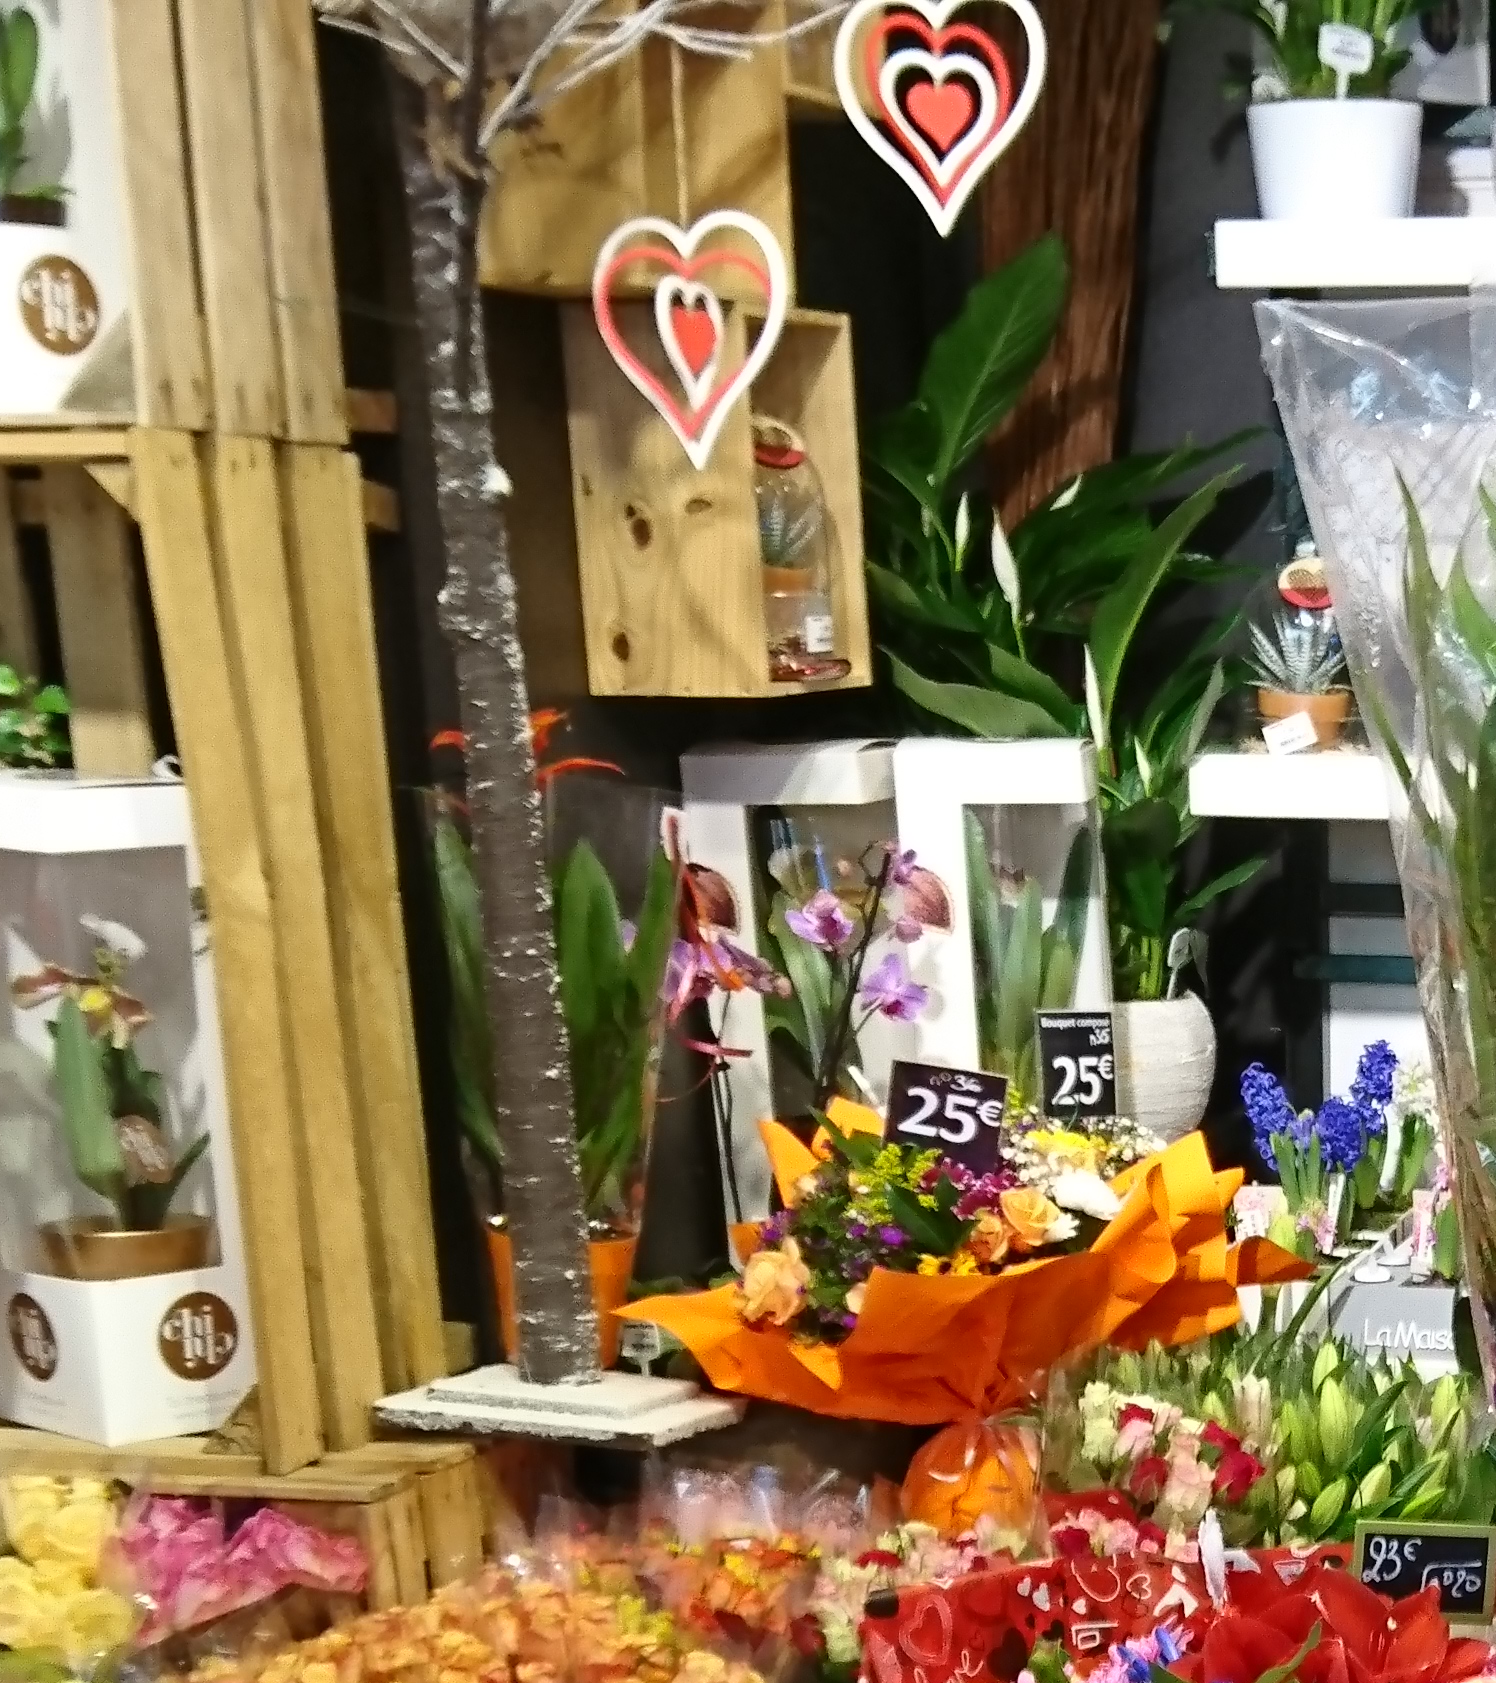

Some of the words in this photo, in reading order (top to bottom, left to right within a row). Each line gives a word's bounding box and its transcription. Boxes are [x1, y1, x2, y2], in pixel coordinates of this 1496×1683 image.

[1050, 1054, 1115, 1107] 25€
[896, 1085, 1004, 1145] 25€
[1363, 1317, 1392, 1349] La
